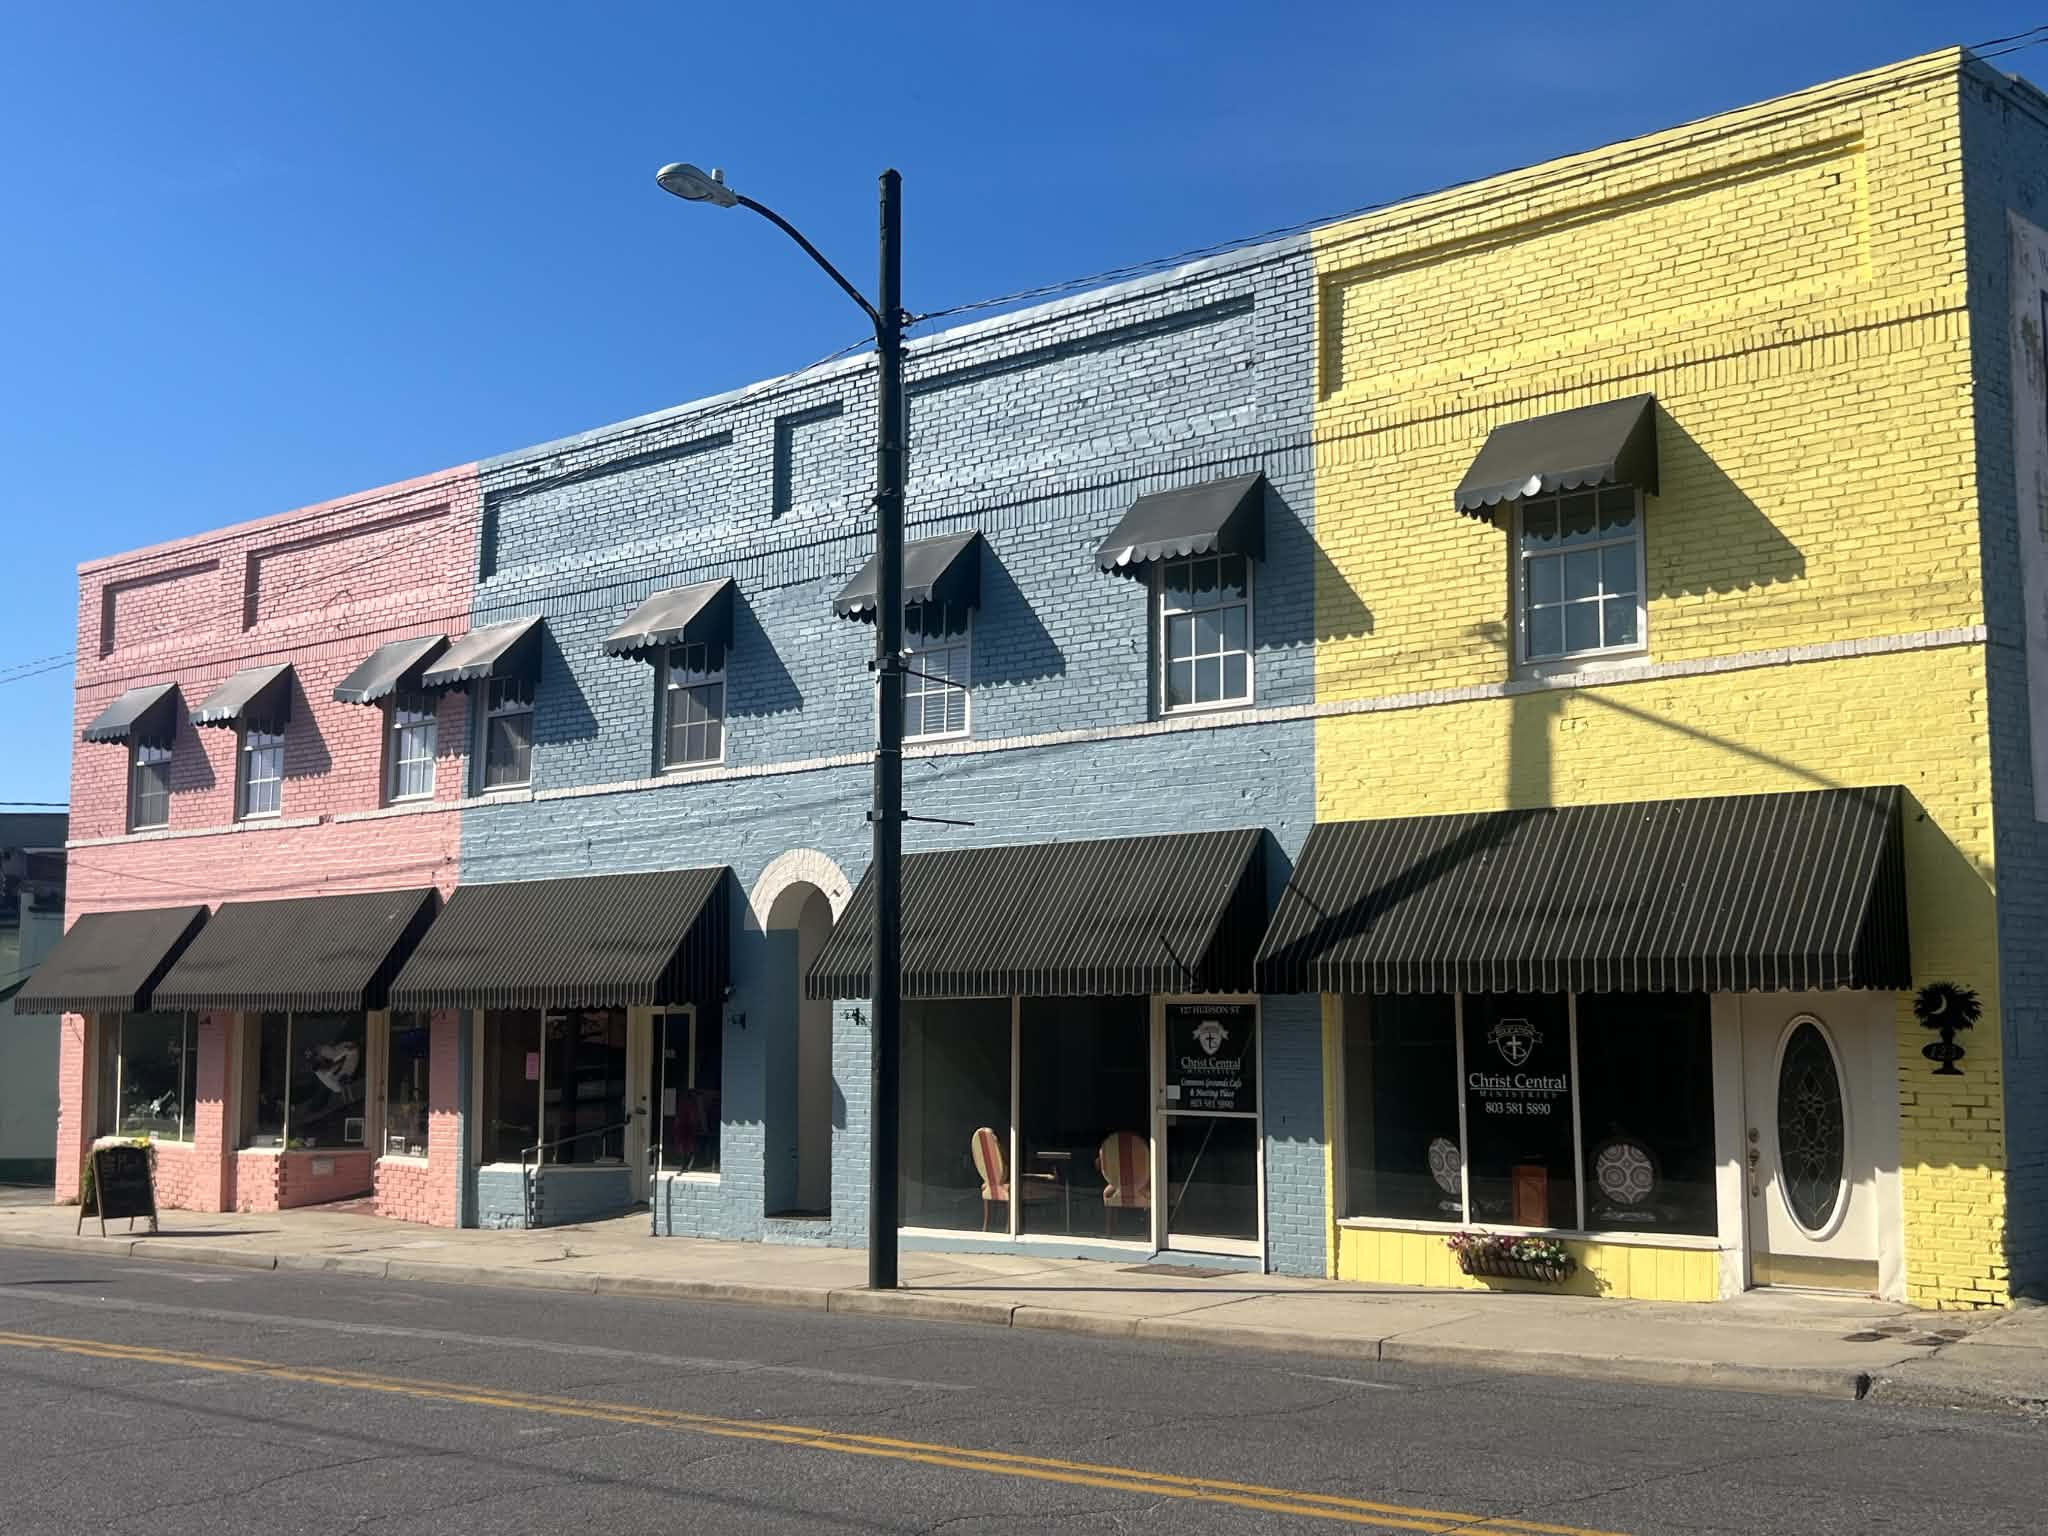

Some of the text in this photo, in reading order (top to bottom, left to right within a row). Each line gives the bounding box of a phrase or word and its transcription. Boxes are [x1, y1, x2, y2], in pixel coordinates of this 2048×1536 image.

[1181, 1056, 1240, 1068] Christ Central
[1469, 1072, 1567, 1089] Christ Central
[1485, 1102, 1551, 1115] 803 581 5890
